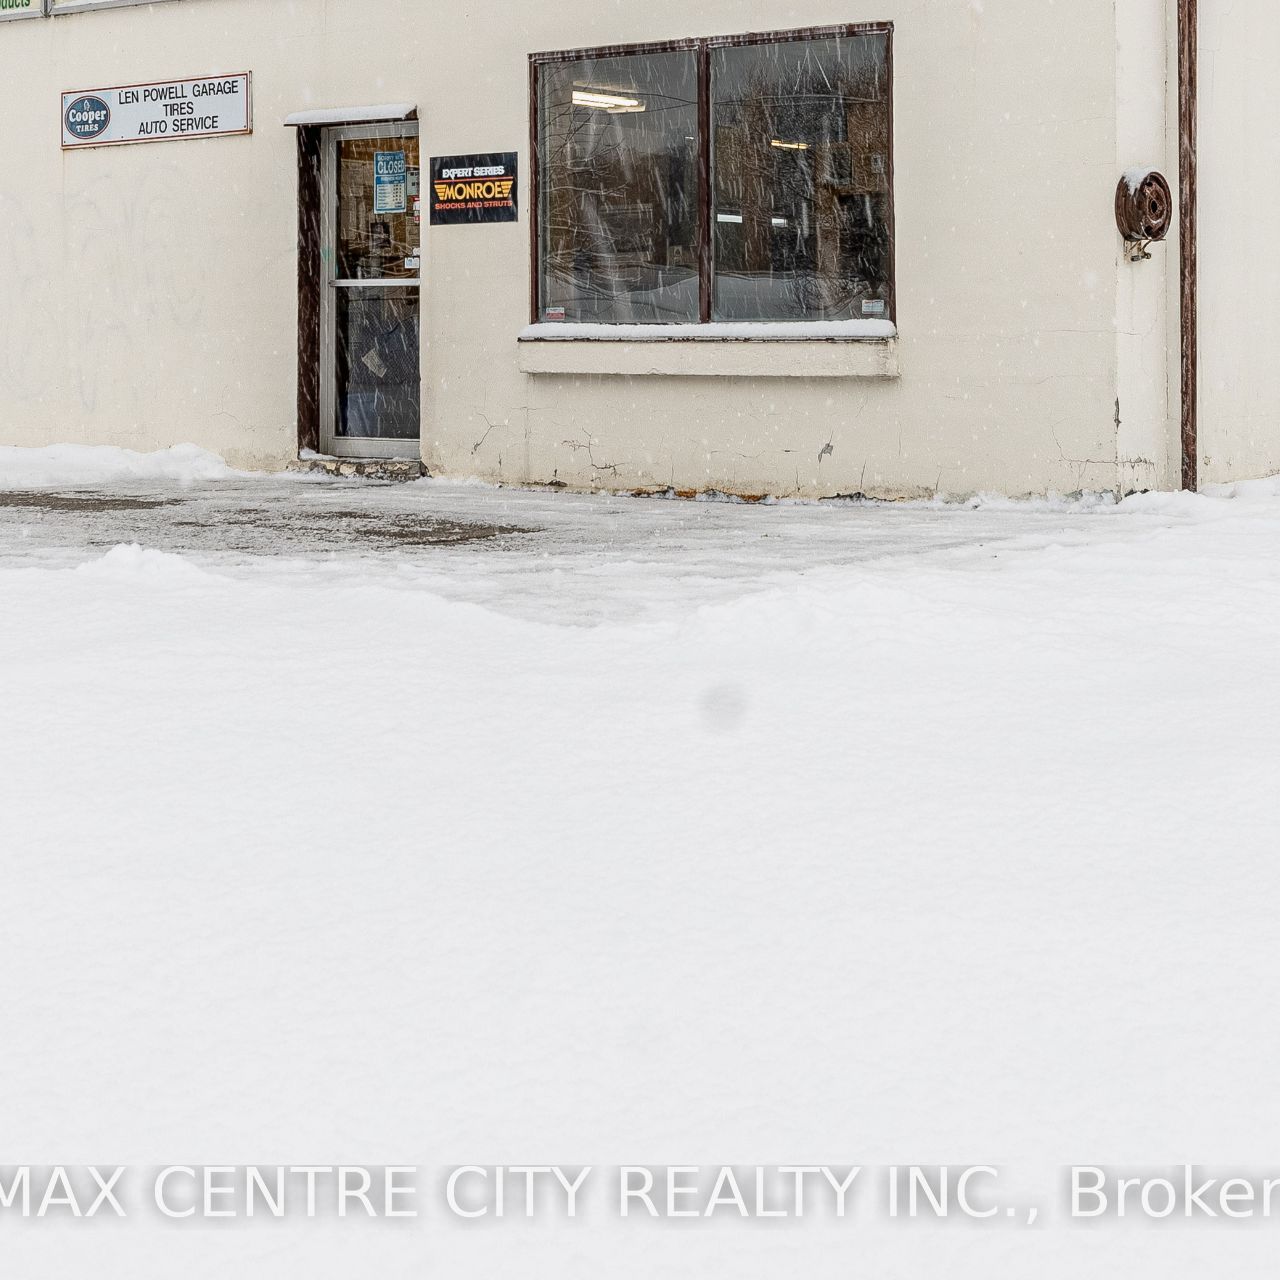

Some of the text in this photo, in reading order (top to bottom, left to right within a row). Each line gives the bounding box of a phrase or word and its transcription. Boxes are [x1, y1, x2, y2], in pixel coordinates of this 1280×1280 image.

[119, 80, 238, 104] LEN POWELL GARAGE
[163, 102, 194, 116] TIRES
[69, 109, 106, 124] Cooper
[76, 124, 99, 132] TIRES
[138, 116, 218, 135] AUTO SERVICE
[378, 160, 405, 174] CLOSED
[442, 166, 505, 179] EXPERT SERIES
[444, 181, 503, 200] MONROE
[435, 202, 466, 210] SHOCKS
